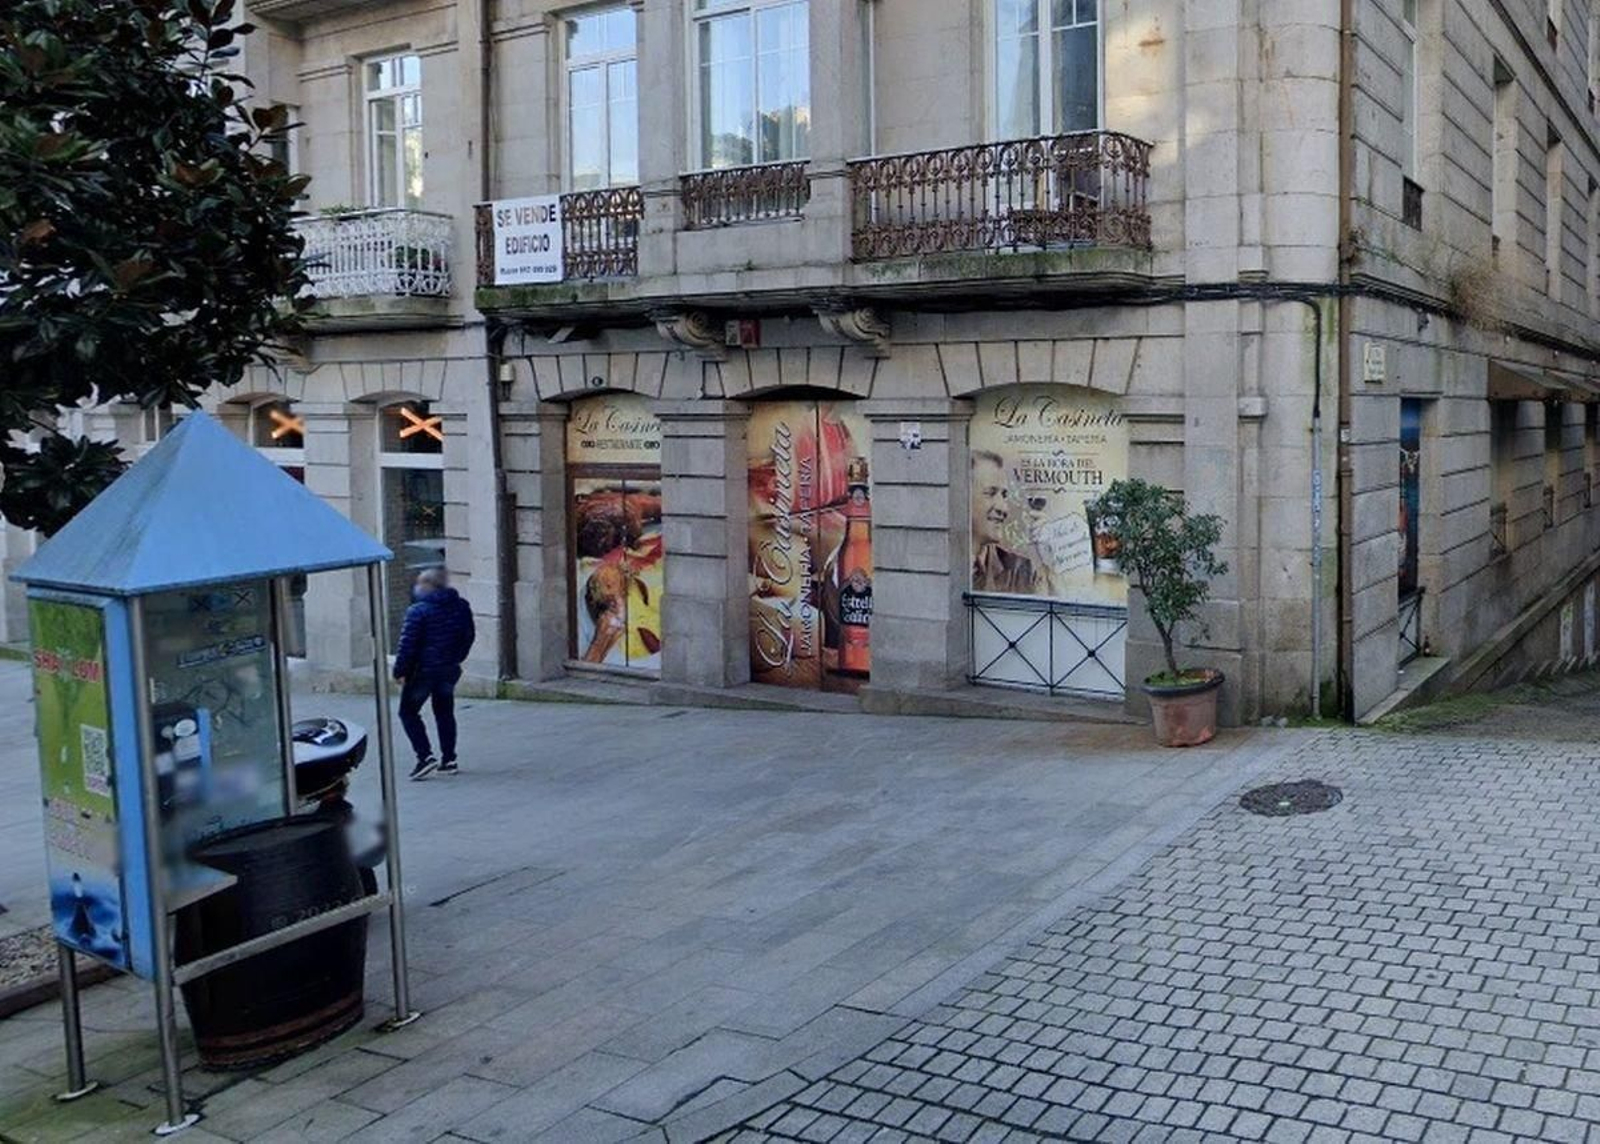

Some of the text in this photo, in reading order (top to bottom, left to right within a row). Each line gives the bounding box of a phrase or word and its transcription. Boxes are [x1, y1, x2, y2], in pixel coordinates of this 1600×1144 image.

[497, 204, 557, 228] SE VENDE
[505, 234, 550, 255] EDIFICIO
[992, 396, 1124, 428] La Casineta
[1013, 469, 1103, 485] VERMOUTH
[754, 419, 796, 670] La Casineta
